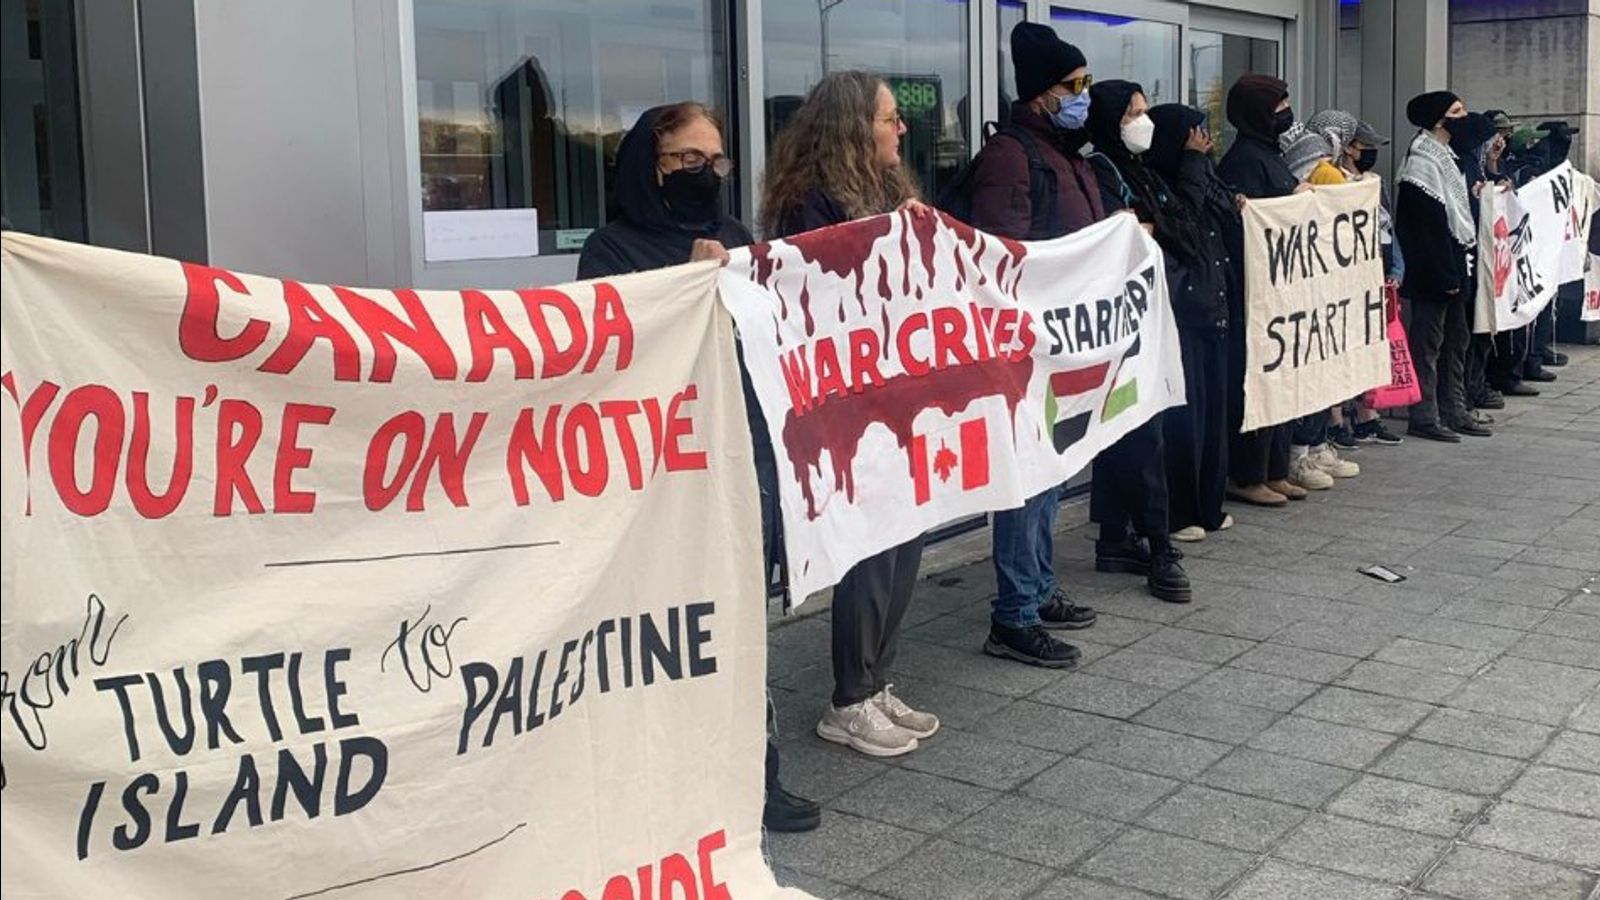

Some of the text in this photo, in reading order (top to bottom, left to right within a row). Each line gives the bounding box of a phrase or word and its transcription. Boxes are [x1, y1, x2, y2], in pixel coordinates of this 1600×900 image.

[1264, 219, 1328, 288] WAR
[179, 261, 634, 383] CANADA
[778, 326, 888, 417] WAR
[896, 302, 1036, 377] CRIES
[1043, 294, 1123, 356] START
[1263, 286, 1384, 373] START H
[1, 370, 708, 519] YOU'RE ON NOTIE
[94, 648, 360, 762] TURTLE
[381, 604, 468, 693] to
[456, 601, 718, 756] PALESTINE
[77, 736, 388, 861] ISLAND
